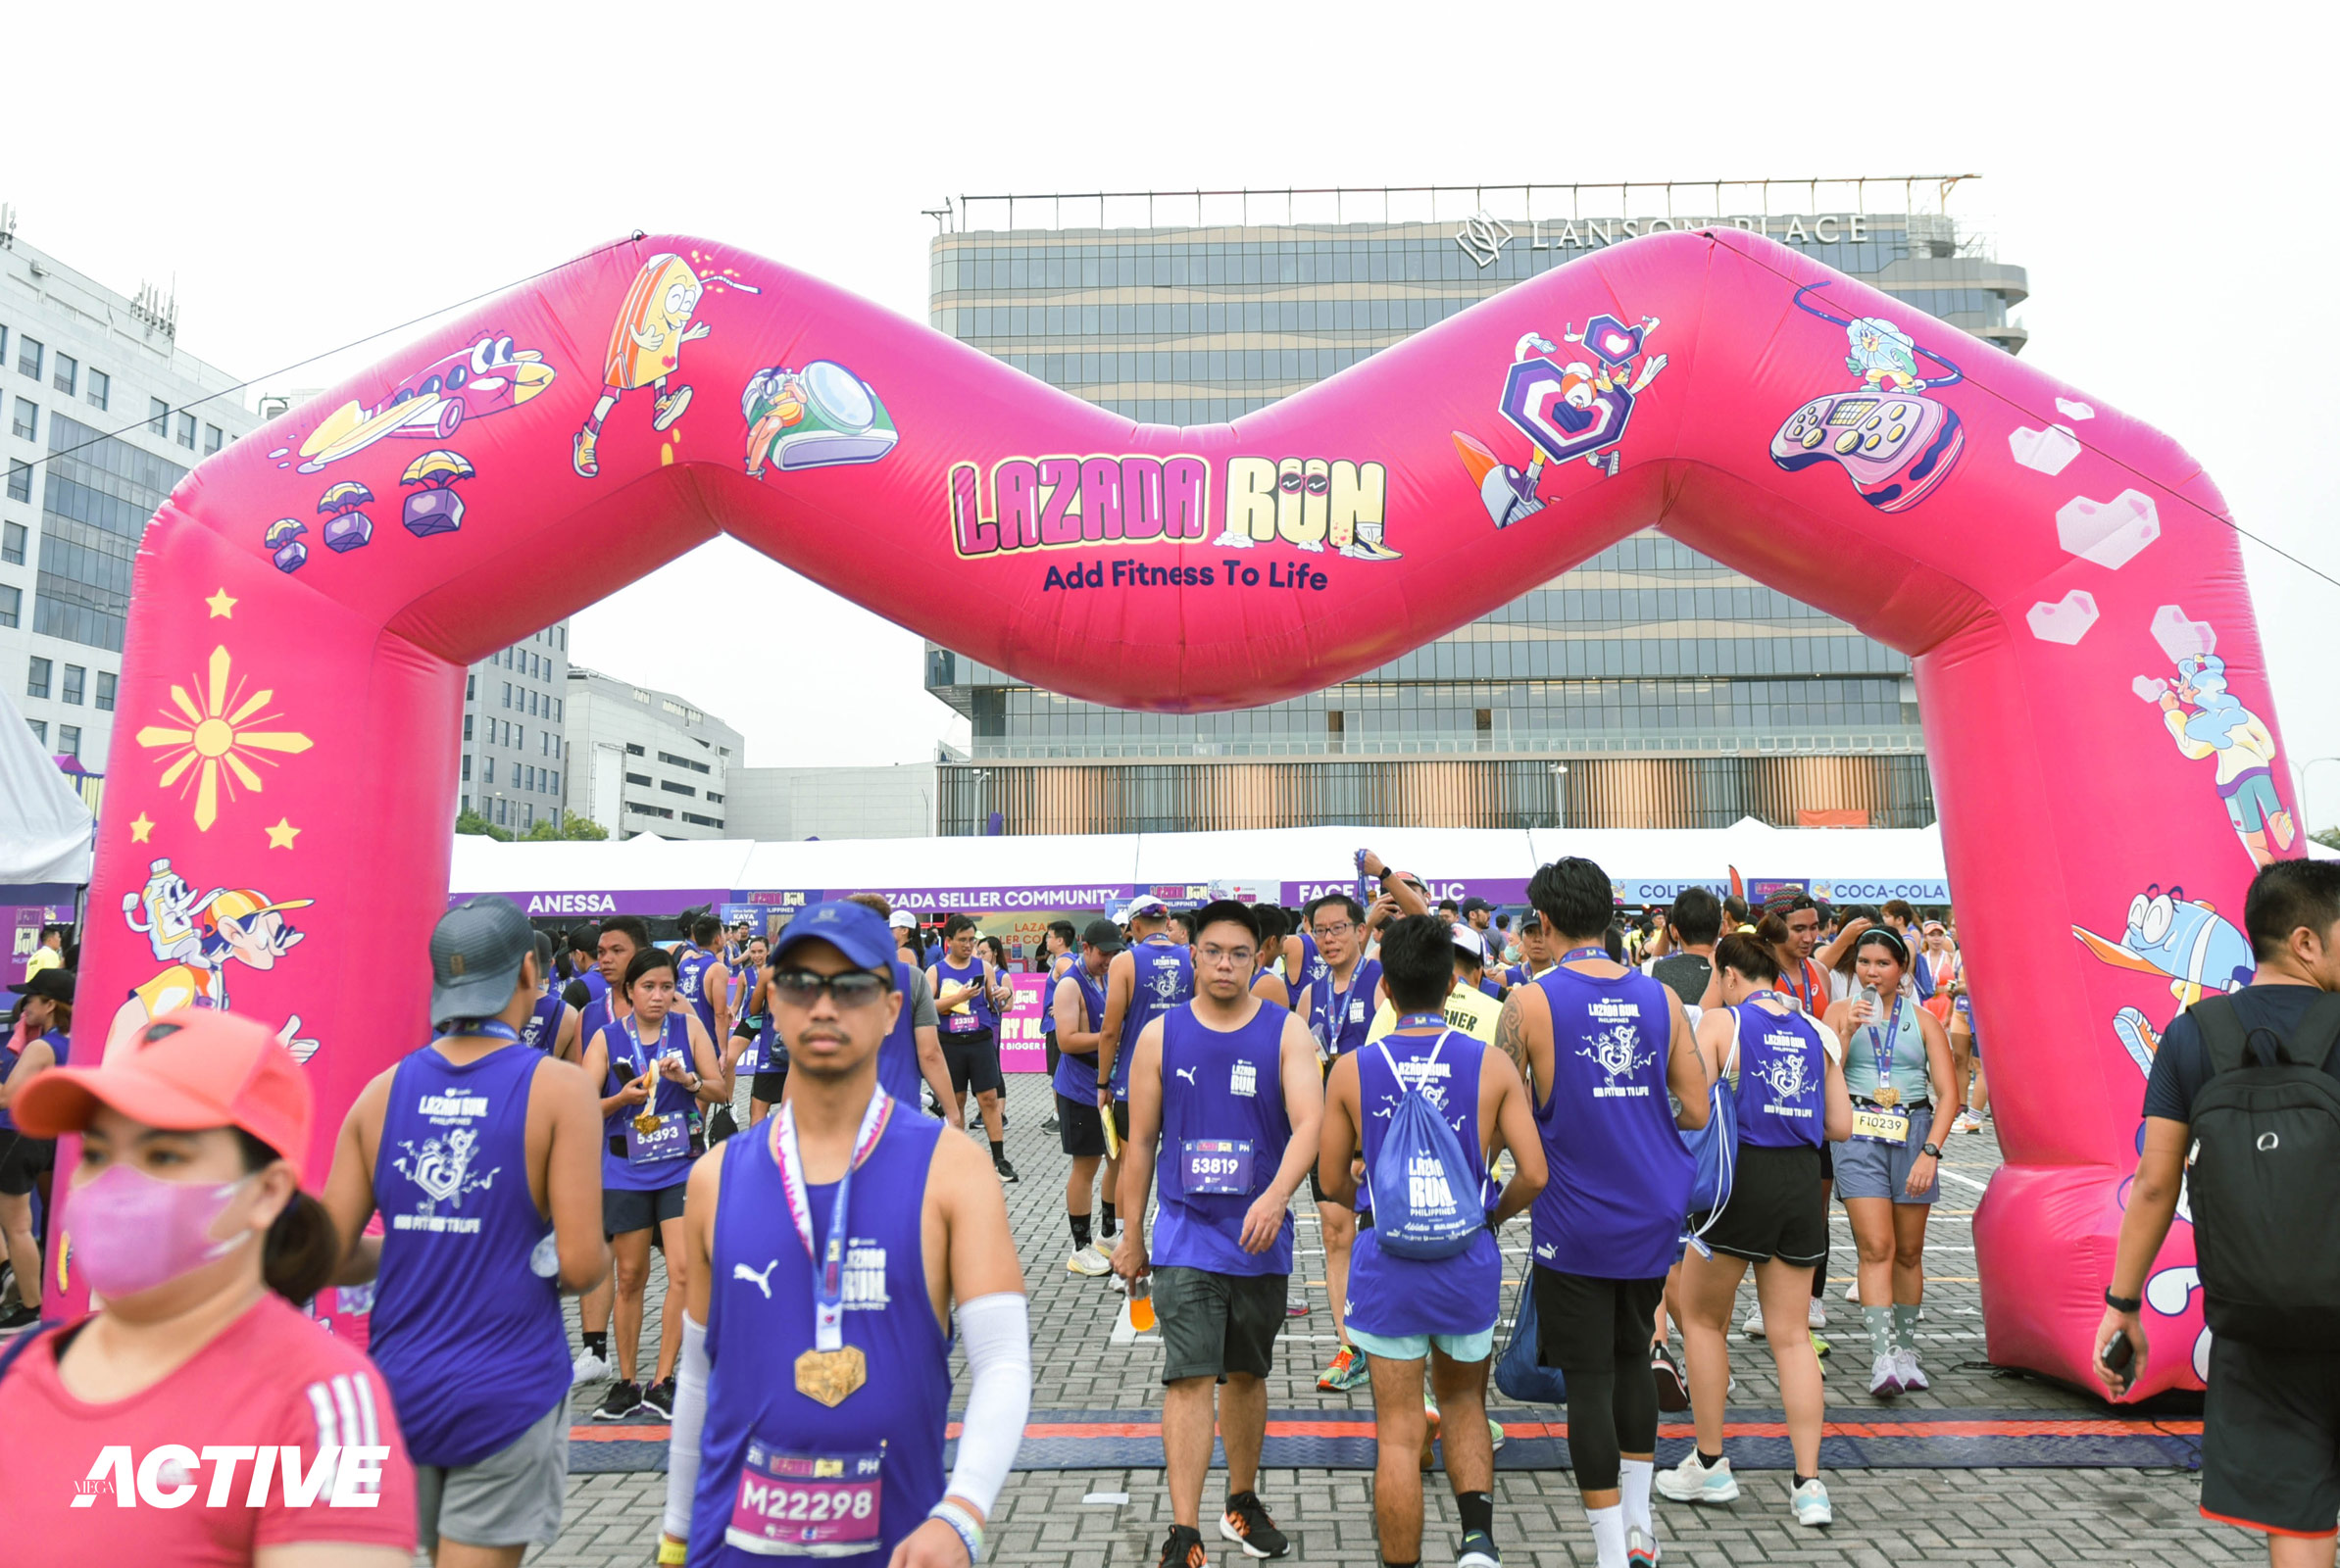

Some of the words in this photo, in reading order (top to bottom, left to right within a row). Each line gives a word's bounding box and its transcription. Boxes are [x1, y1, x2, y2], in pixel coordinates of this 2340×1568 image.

[949, 454, 1210, 560] LAZADA
[1226, 456, 1388, 550] RUN
[1043, 563, 1103, 591] Add
[1113, 559, 1214, 587] Fitness
[1222, 560, 1259, 587] To
[1270, 563, 1328, 591] Life
[885, 892, 935, 908] ZADA
[938, 891, 1002, 908] SELLER
[1004, 889, 1120, 906] COMMUNITY
[1299, 884, 1354, 903] FACE
[1639, 884, 1728, 899] COLEAN
[1835, 884, 1945, 899] COCA-COLA
[527, 894, 617, 913] ANESSA
[1015, 922, 1051, 933] LAZA
[1588, 1004, 1618, 1017] LAZADA
[1618, 1004, 1641, 1017] RUN
[1006, 1042, 1041, 1051] BIGGER
[1764, 1034, 1790, 1048] LAZADA
[1231, 1063, 1256, 1077] LAZADA
[1398, 1061, 1428, 1076] AZAD
[1230, 1074, 1257, 1094] RUN
[419, 1095, 461, 1115] LAZADA
[1238, 1143, 1250, 1152] PH
[1191, 1157, 1239, 1175] 53819
[1409, 1176, 1458, 1208] RUN
[1410, 1206, 1457, 1217] PHILIPPINES
[843, 1248, 886, 1270] AZADA
[857, 1457, 881, 1476] PH
[742, 1479, 872, 1522] M22298
